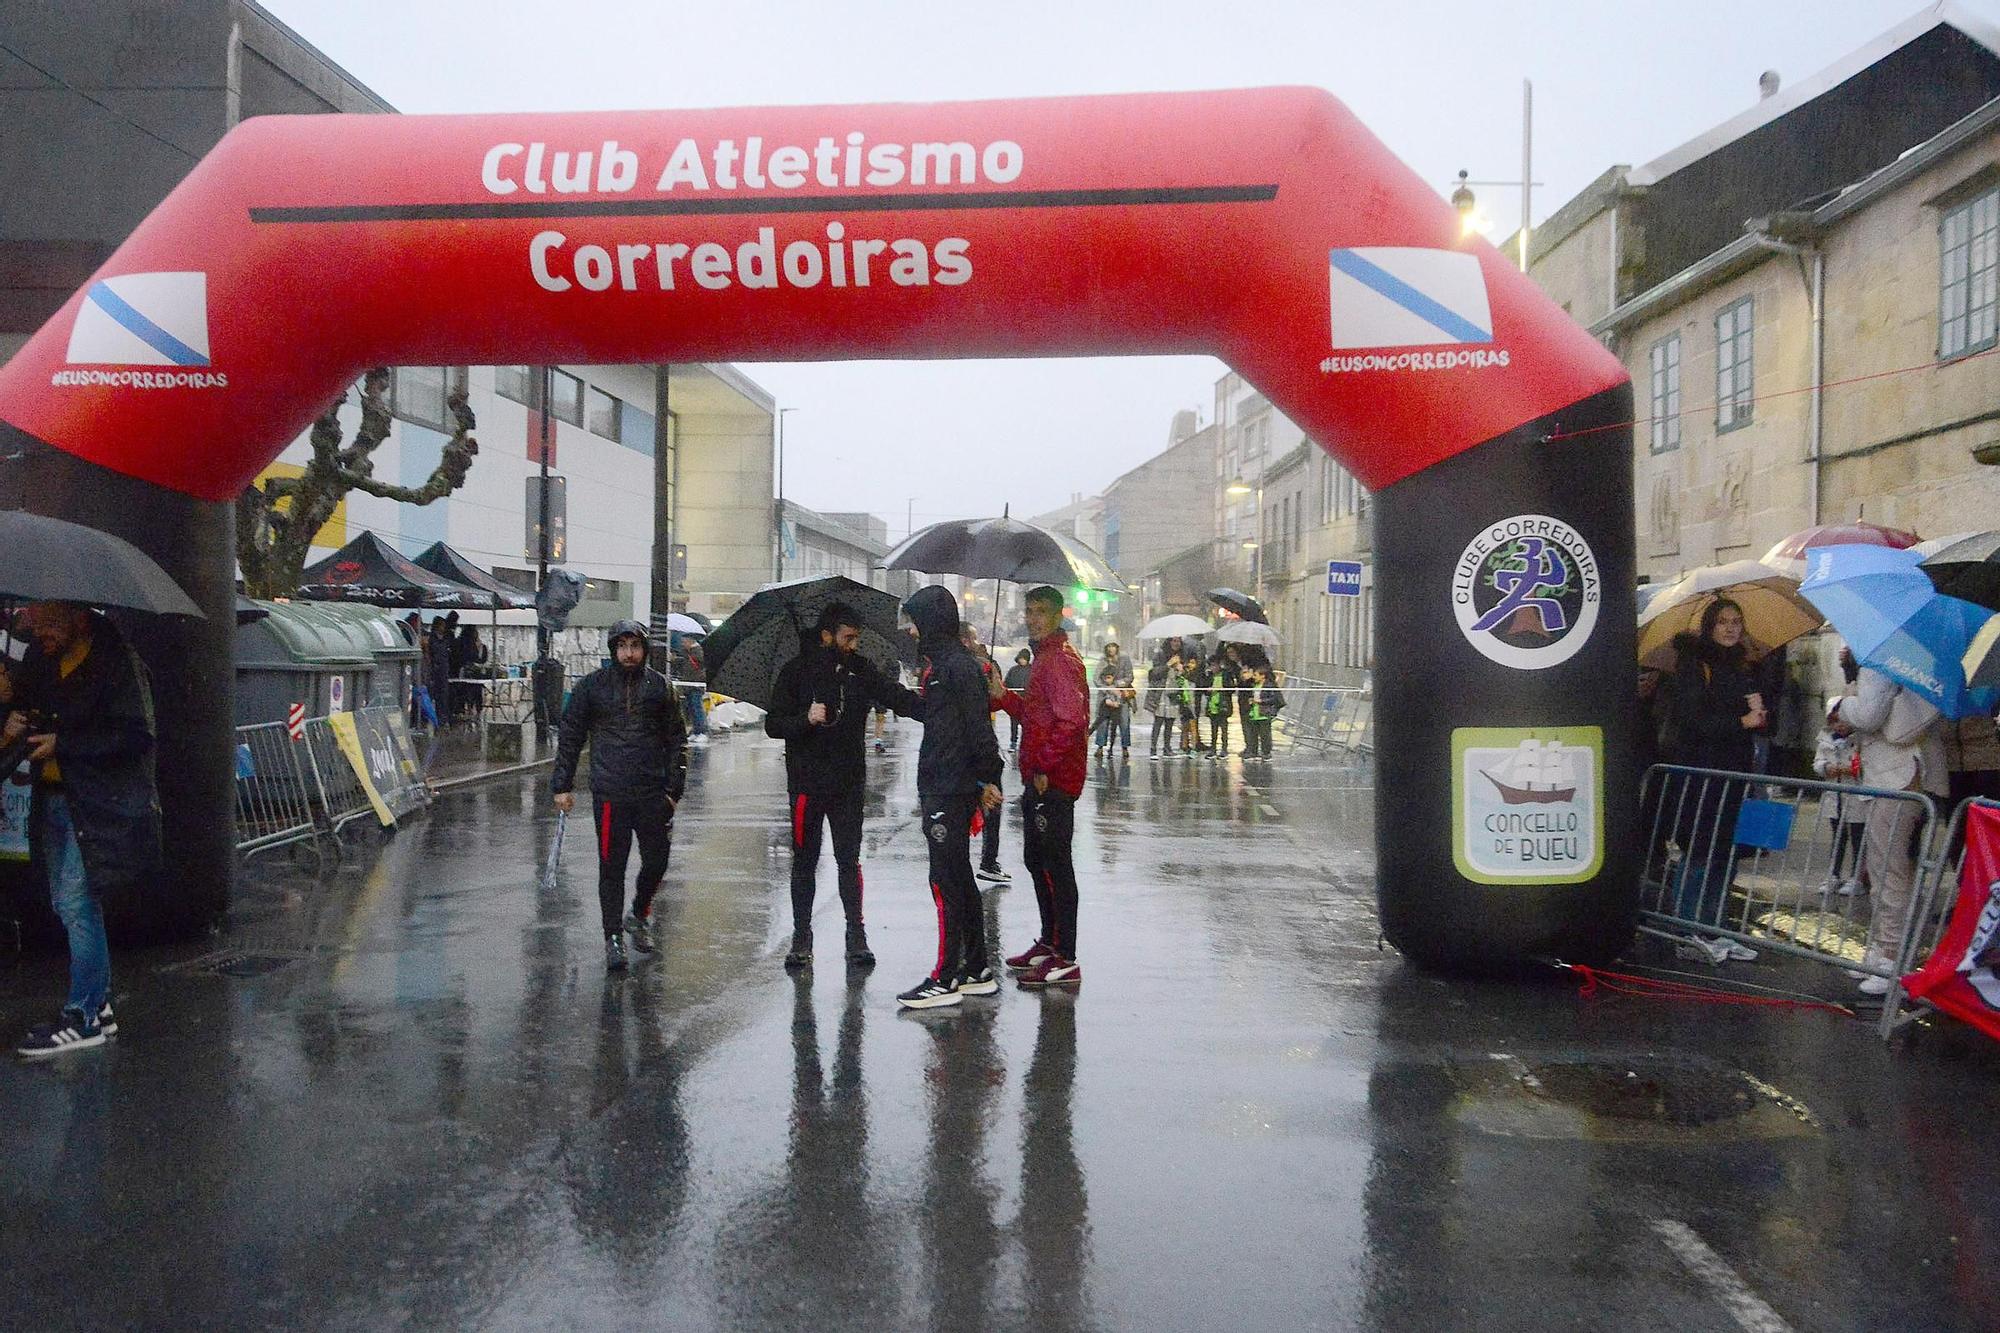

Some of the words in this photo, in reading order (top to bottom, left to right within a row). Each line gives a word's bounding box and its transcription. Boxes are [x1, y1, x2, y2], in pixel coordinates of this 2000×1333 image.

[482, 140, 638, 194] Club
[656, 132, 1024, 191] Atletismo
[529, 221, 973, 293] Corredoiras
[1319, 350, 1510, 373] #EUSONCORREDOIRAS
[52, 370, 228, 389] #EUSONCORREDOIRAS
[1455, 539, 1490, 605] CLUBE
[1491, 519, 1597, 603] CORREDOIRAS
[1330, 572, 1360, 584] TAXI
[1485, 812, 1577, 833] CONCELLO
[1494, 838, 1513, 853] DE
[1521, 837, 1577, 861] BUEU
